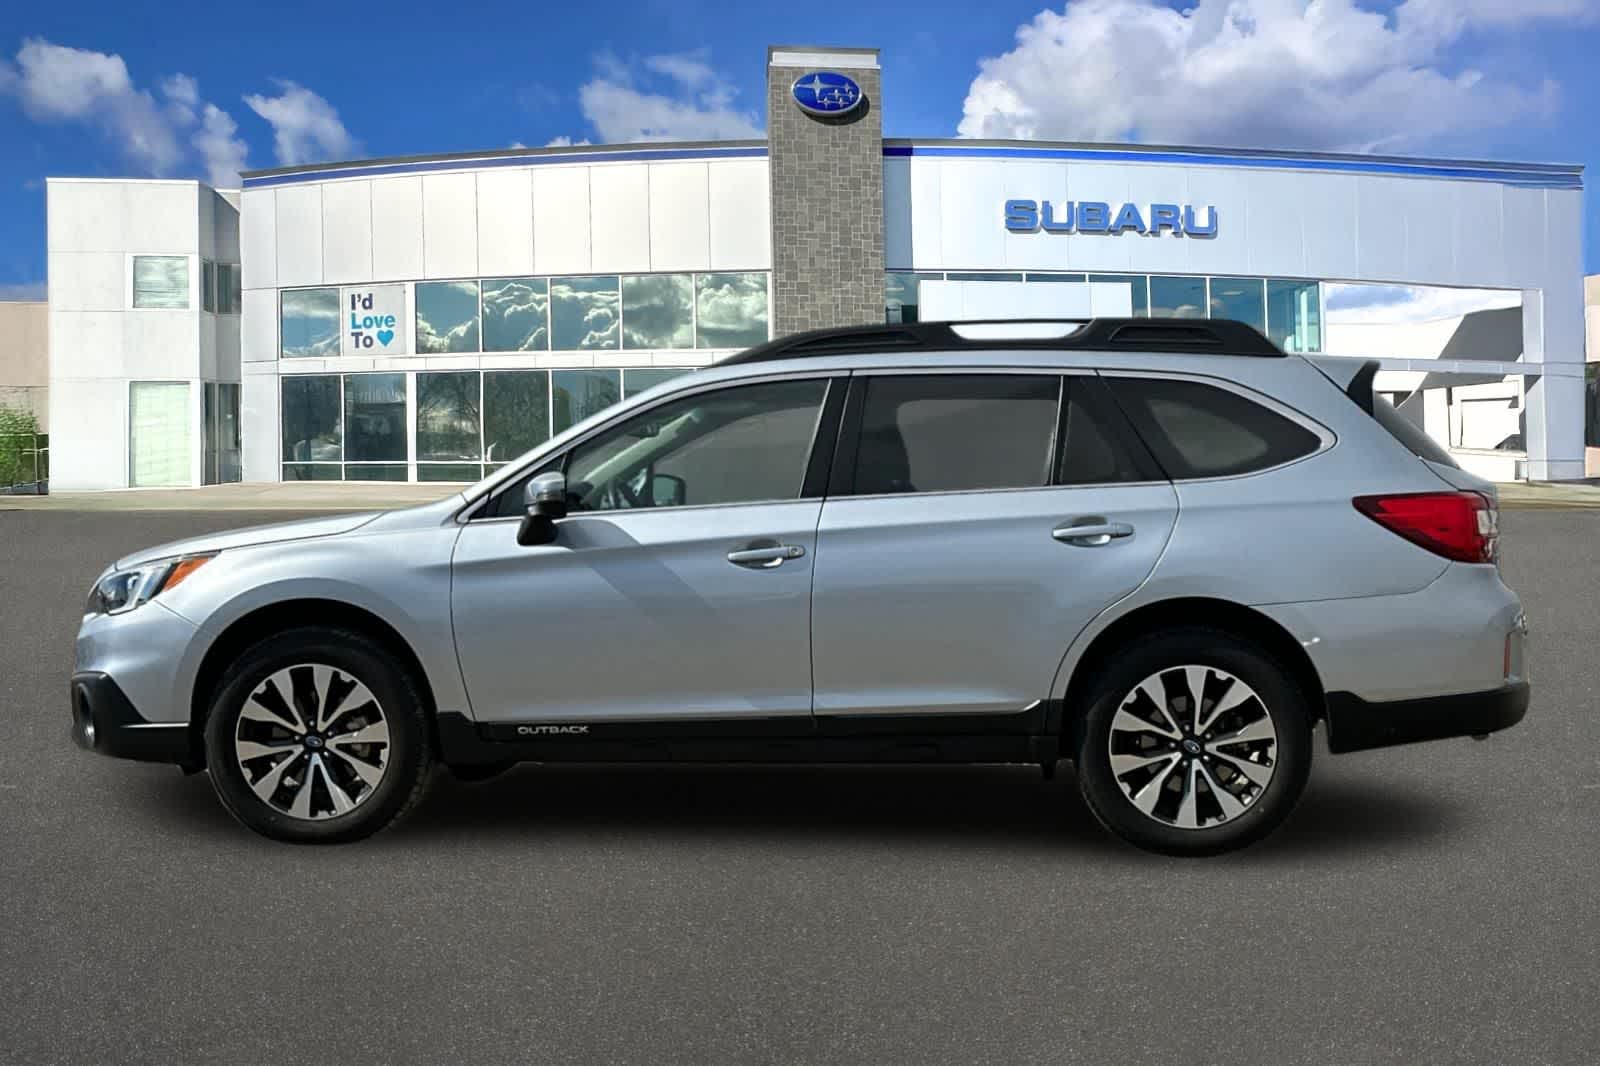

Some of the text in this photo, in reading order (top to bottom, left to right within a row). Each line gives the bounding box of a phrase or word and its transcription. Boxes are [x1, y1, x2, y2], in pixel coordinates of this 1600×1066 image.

[1005, 200, 1217, 238] SUBARU
[351, 293, 373, 310] I'd
[351, 312, 396, 329] Love
[351, 331, 374, 348] To
[517, 725, 589, 735] OUTBACK
